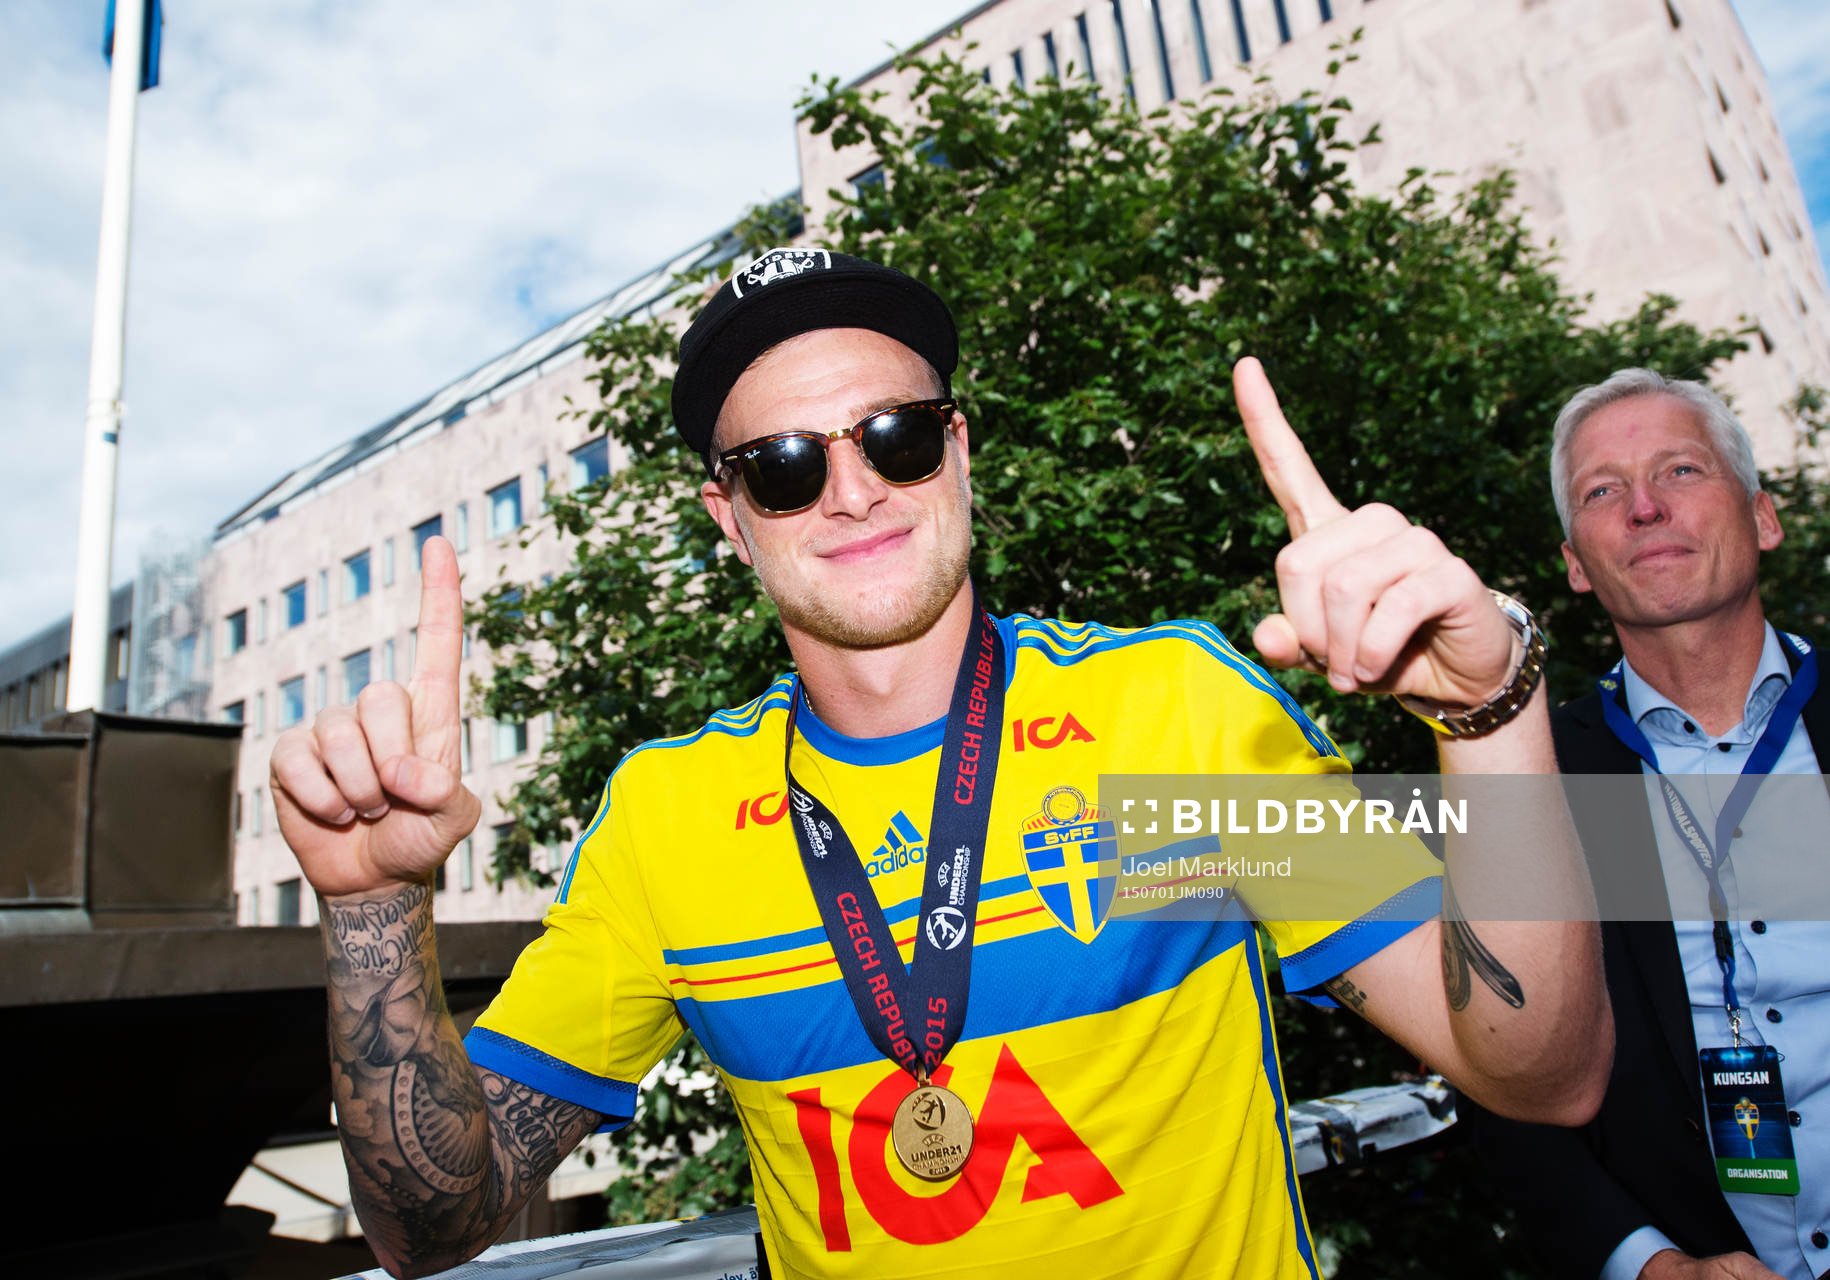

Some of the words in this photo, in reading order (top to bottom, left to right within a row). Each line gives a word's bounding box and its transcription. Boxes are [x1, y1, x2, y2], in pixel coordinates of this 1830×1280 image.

[966, 630, 995, 729] REPUBLIC
[1013, 712, 1096, 752] ICA
[954, 732, 982, 805] CZECH
[735, 791, 789, 830] IC
[1044, 826, 1095, 845] SvFF
[865, 844, 928, 878] adida
[938, 861, 951, 888] UEFA
[957, 847, 971, 906] CHAMPIONSHIP
[836, 892, 881, 971] CZECH
[867, 973, 917, 1077] REPUBL
[924, 997, 948, 1067] 2015
[1713, 1071, 1770, 1086] KUNGSAN
[787, 1042, 1125, 1252] ICA
[911, 1145, 962, 1162] UNDER21
[1727, 1168, 1788, 1180] ORGANISATION
